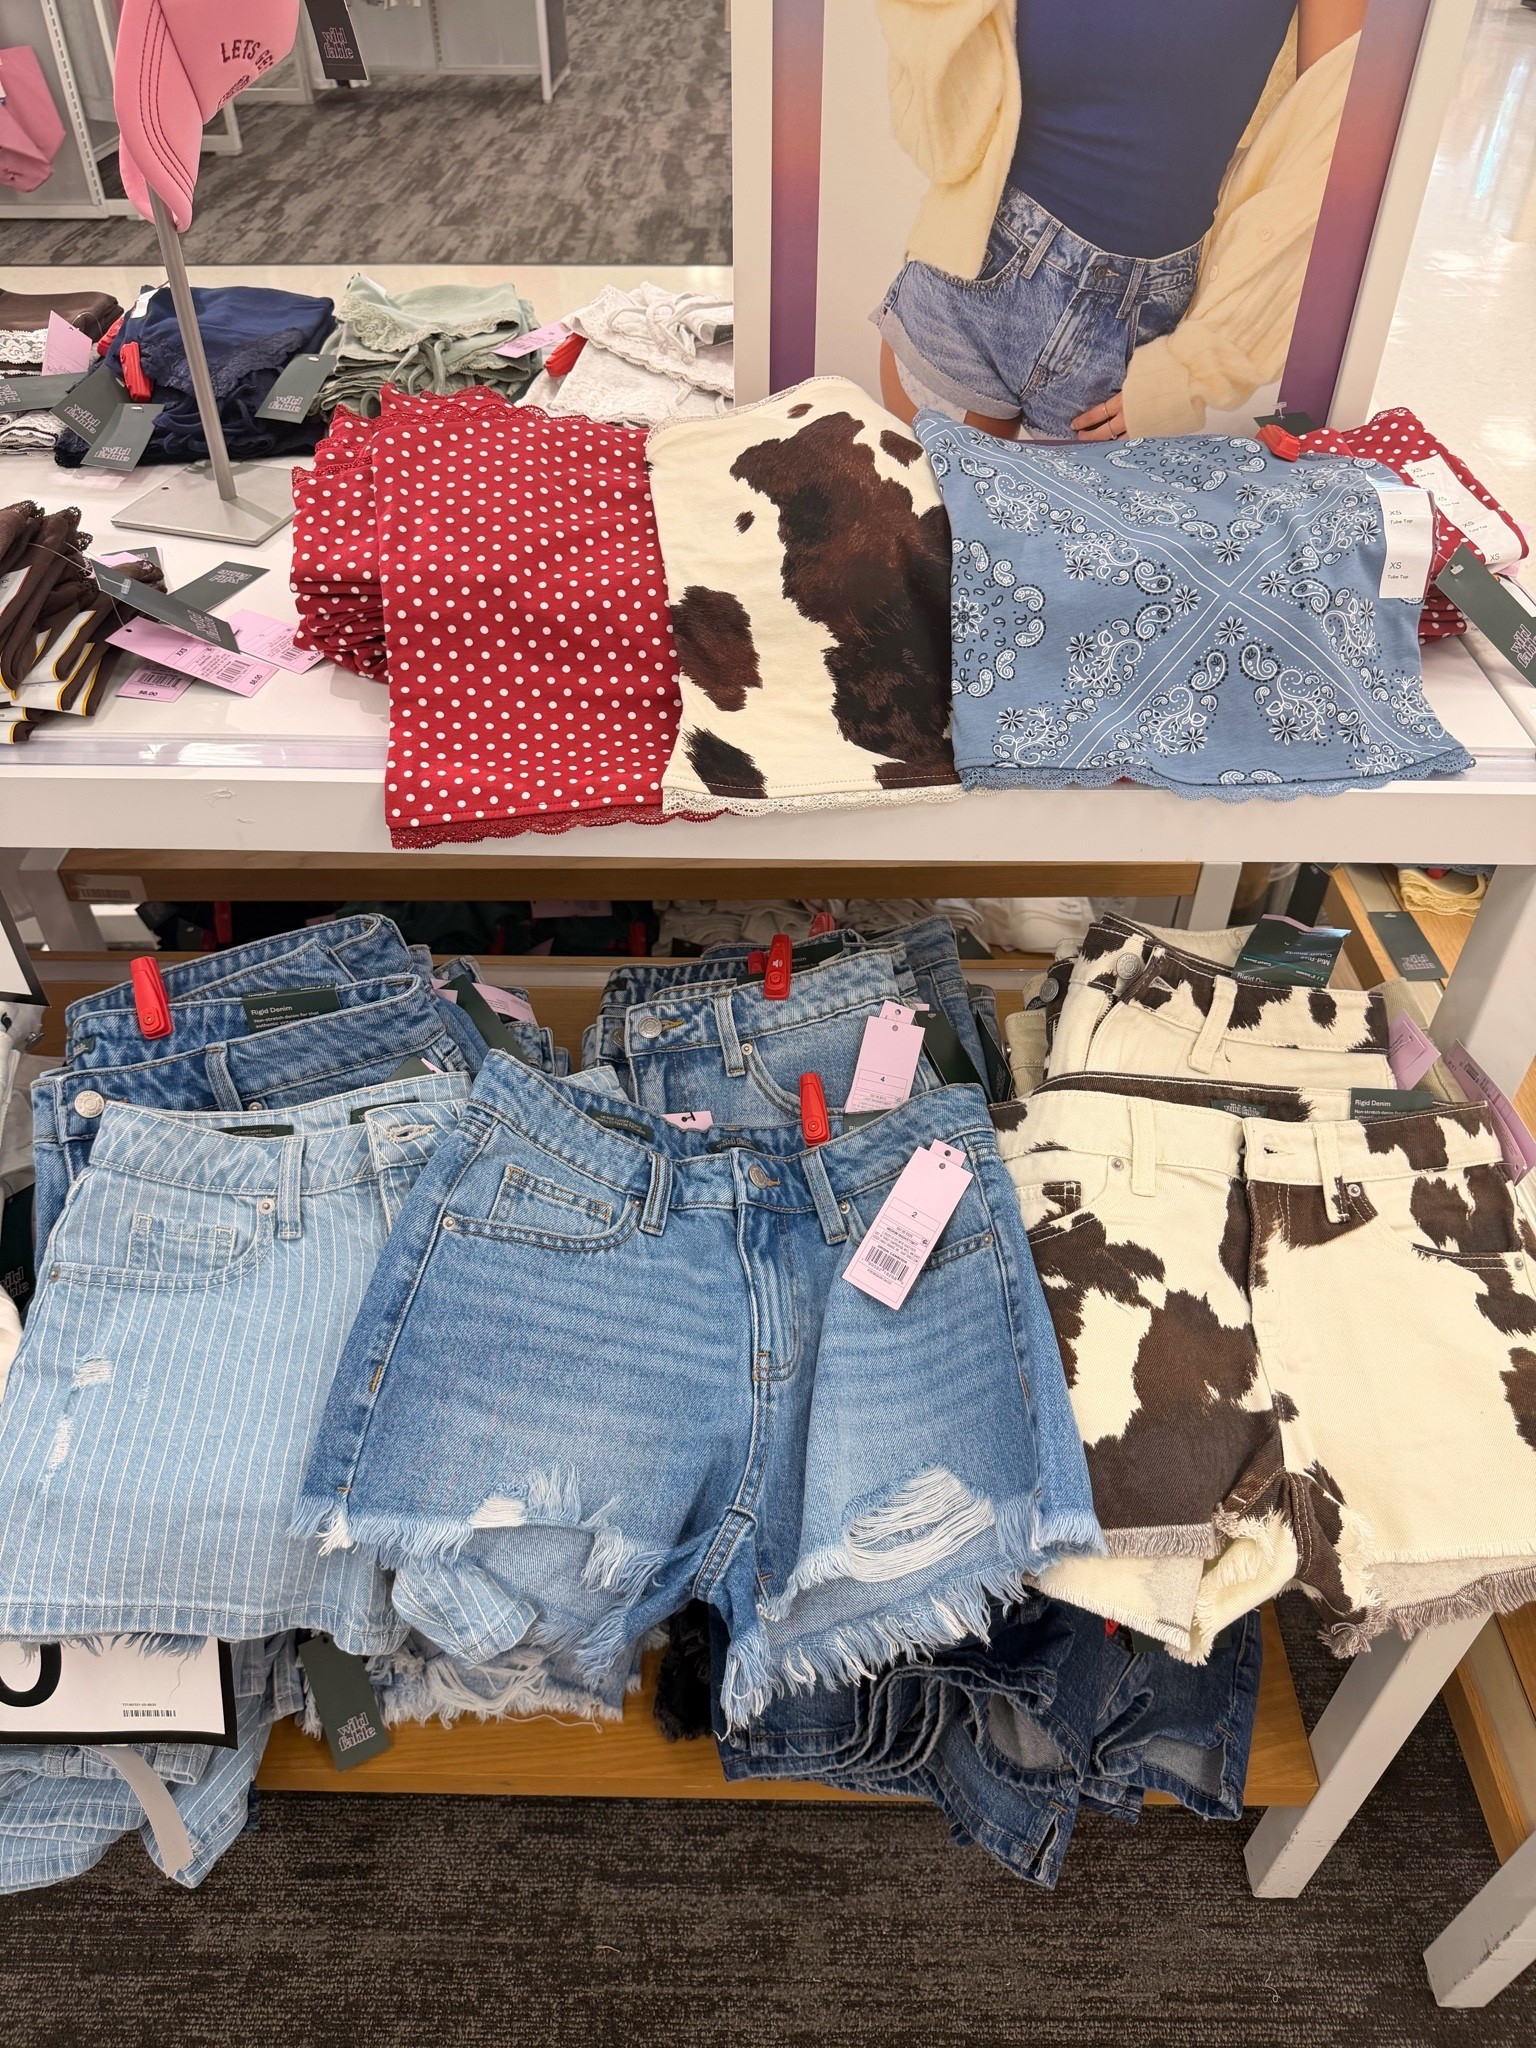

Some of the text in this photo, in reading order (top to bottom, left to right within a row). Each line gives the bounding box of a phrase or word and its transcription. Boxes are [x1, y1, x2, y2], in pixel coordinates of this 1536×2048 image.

[221, 39, 261, 63] LETS
[1389, 561, 1402, 570] XS
[1490, 553, 1500, 562] XS
[1511, 623, 1532, 653] wild
[1517, 635, 1536, 669] fabl
[251, 1005, 293, 1016] Rigid Denim
[1354, 1099, 1370, 1107] Rigid
[337, 1712, 370, 1737] wild
[338, 1726, 376, 1752] fable
